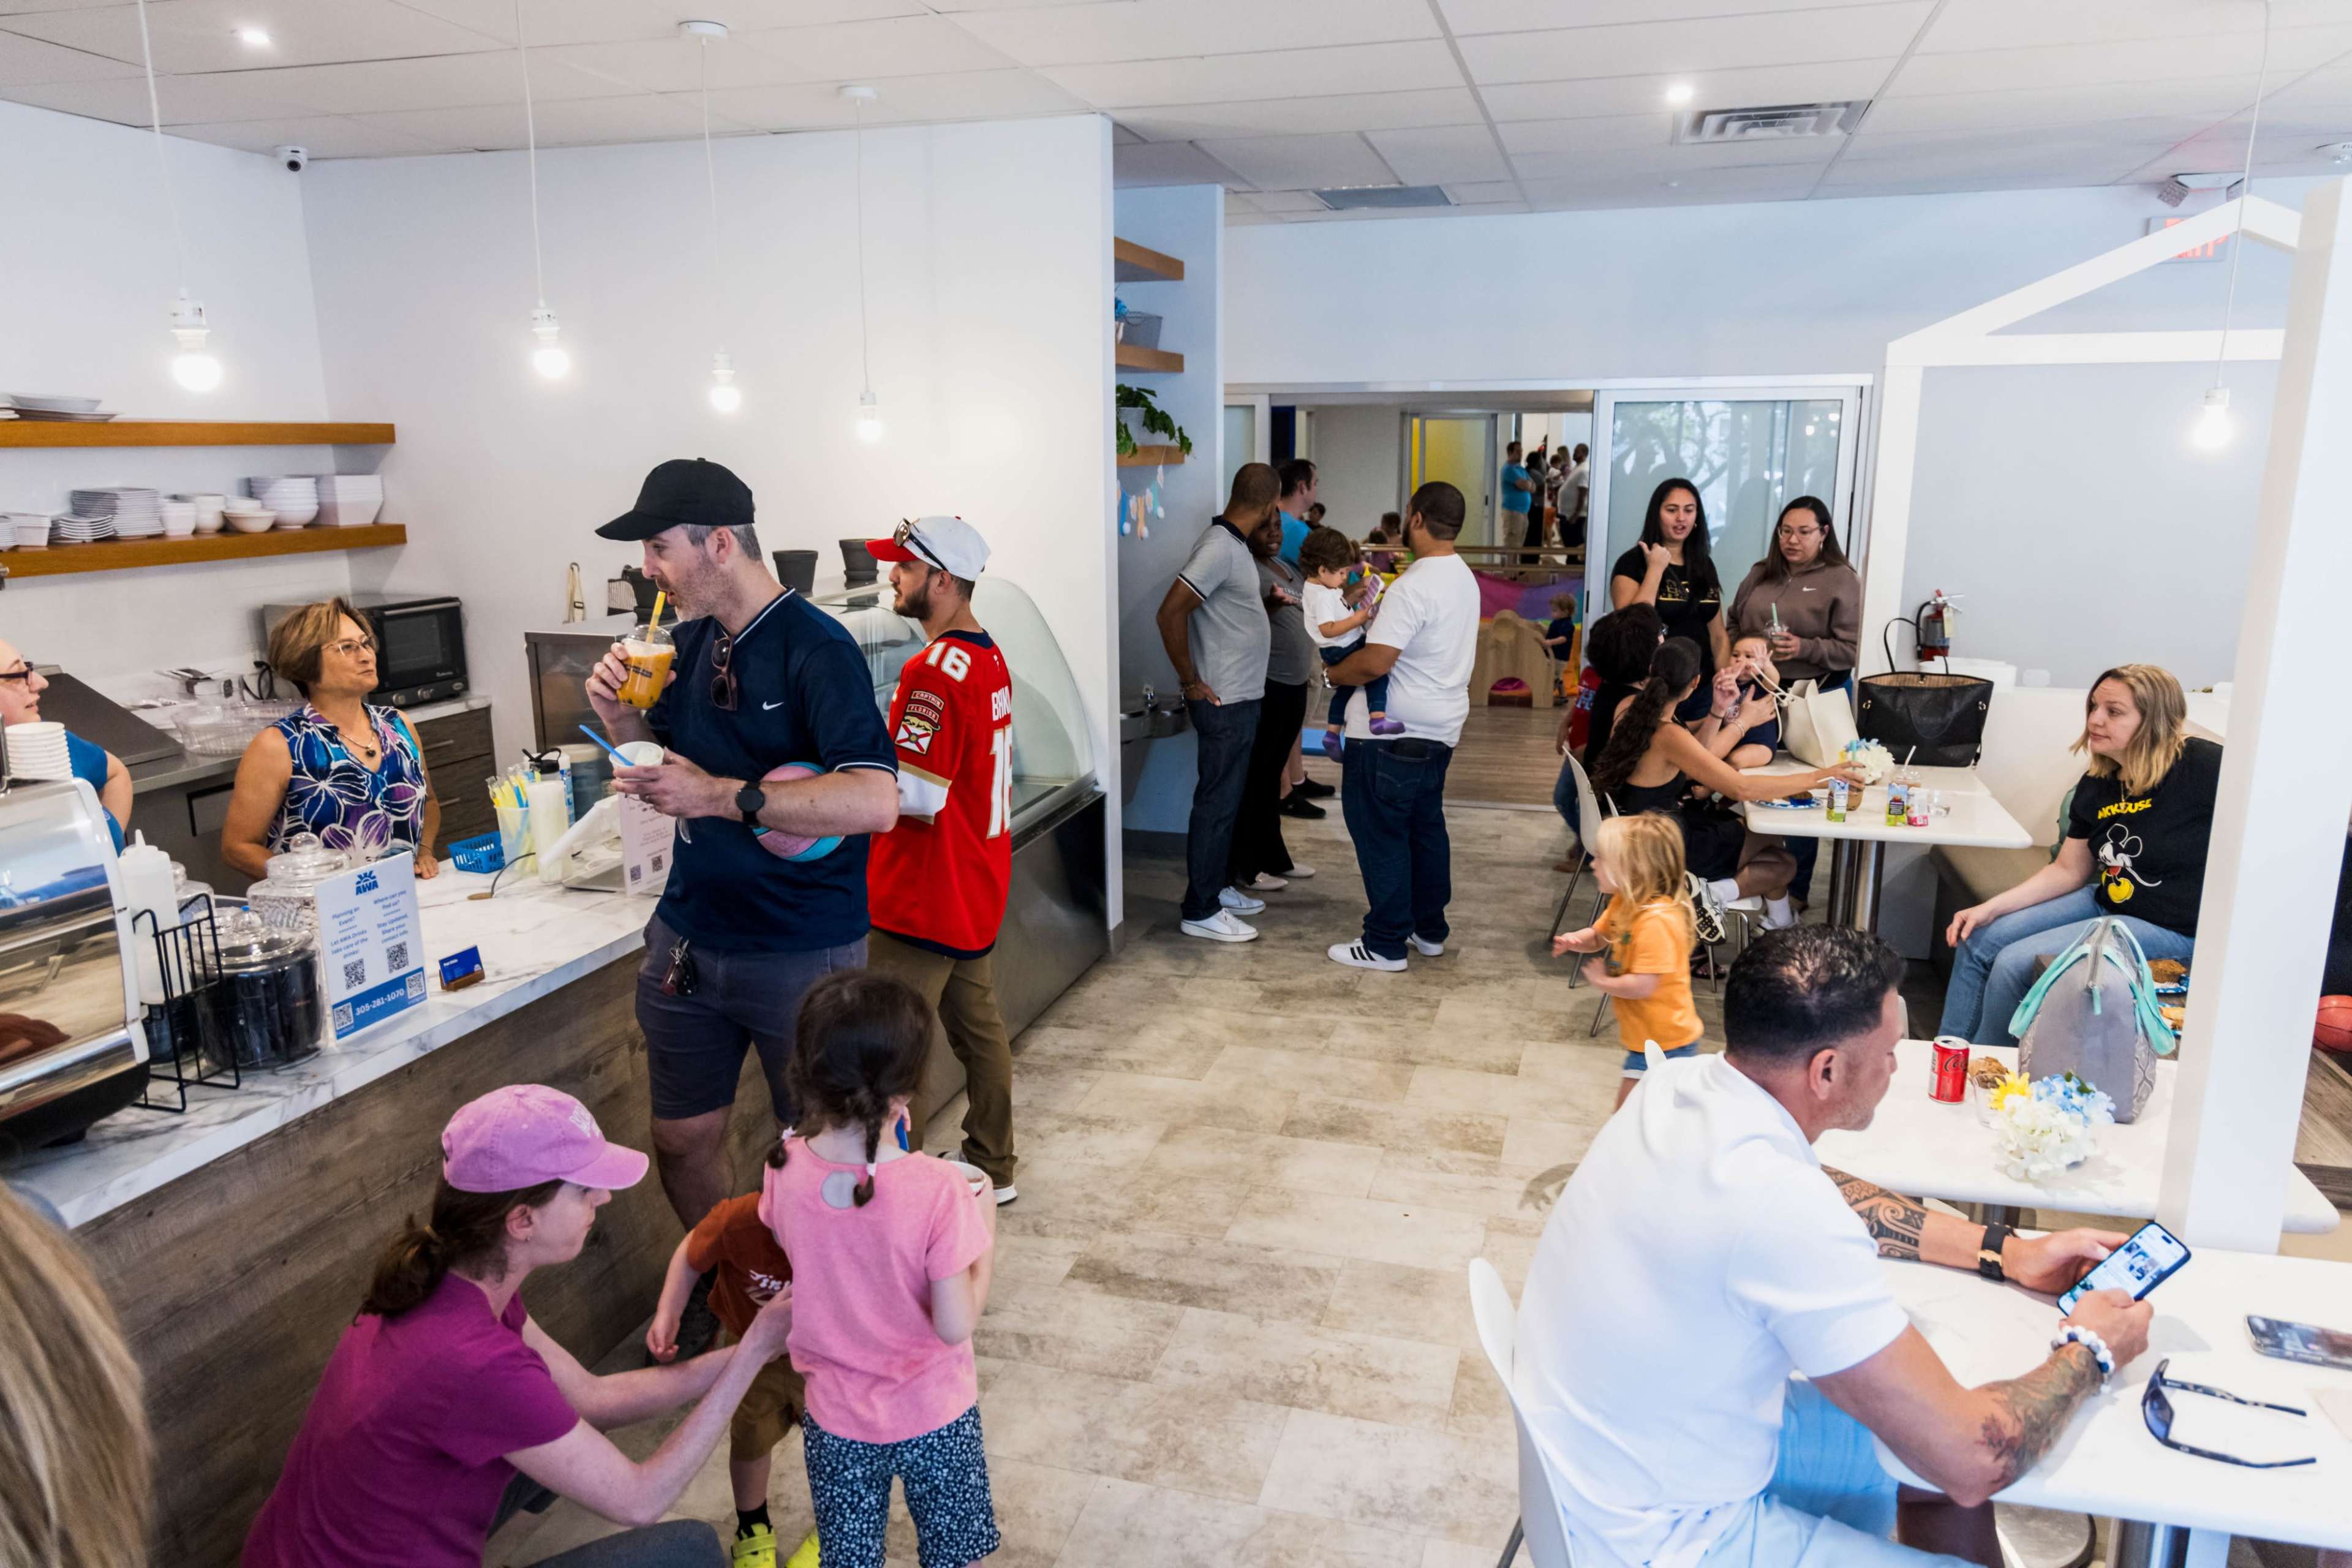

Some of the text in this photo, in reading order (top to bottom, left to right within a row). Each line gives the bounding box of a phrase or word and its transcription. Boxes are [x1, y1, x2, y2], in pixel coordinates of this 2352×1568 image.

[925, 641, 971, 682] 16
[915, 693, 940, 706] CAPTAIN
[911, 706, 937, 720] FLORIDA
[355, 880, 379, 895] AWA
[355, 987, 404, 1016] 305-281-1070
